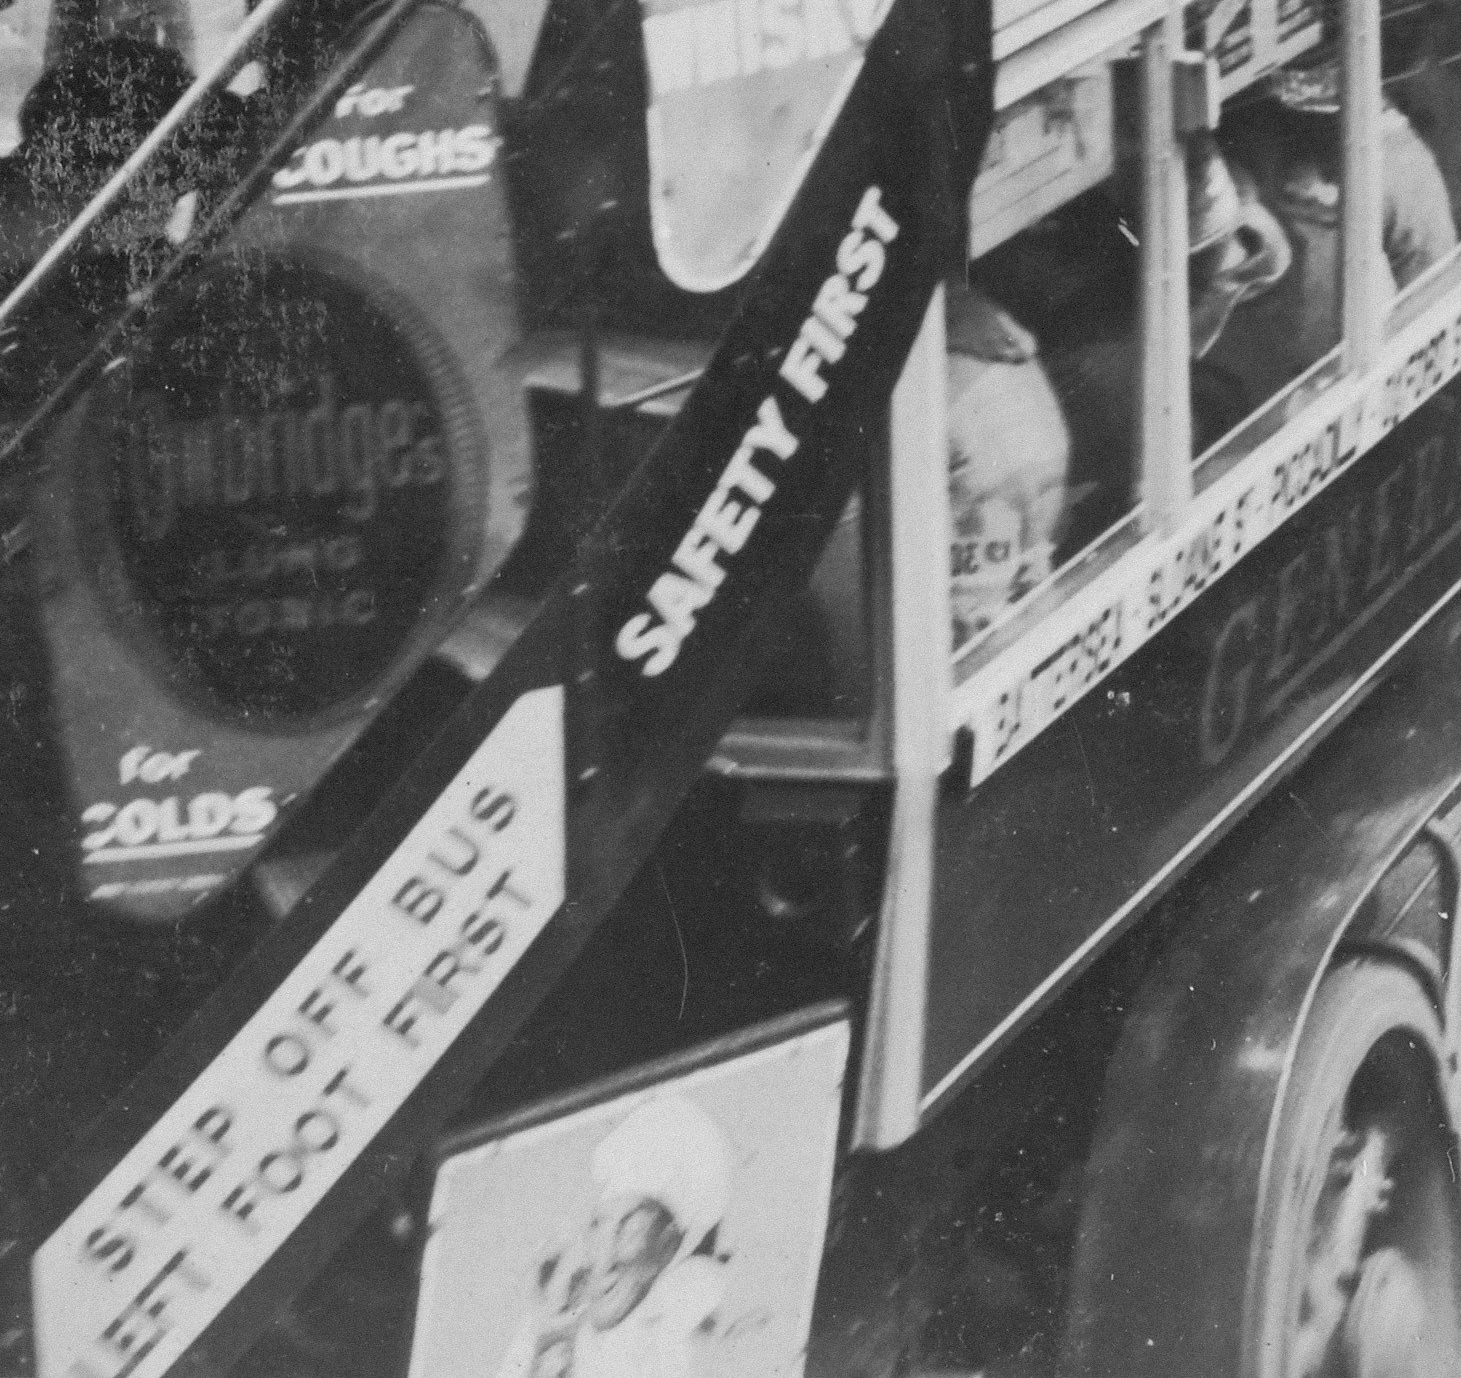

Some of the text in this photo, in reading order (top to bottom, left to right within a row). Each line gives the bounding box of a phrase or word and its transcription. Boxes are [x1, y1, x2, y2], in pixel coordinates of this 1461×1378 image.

[616, 185, 900, 677] SAFETY FIRST
[80, 785, 279, 850] COLDS
[118, 744, 202, 786] for
[80, 785, 518, 1274] STEP OFF BUS
[221, 1067, 374, 1235] FOOT
[383, 870, 537, 1050] FIRST
